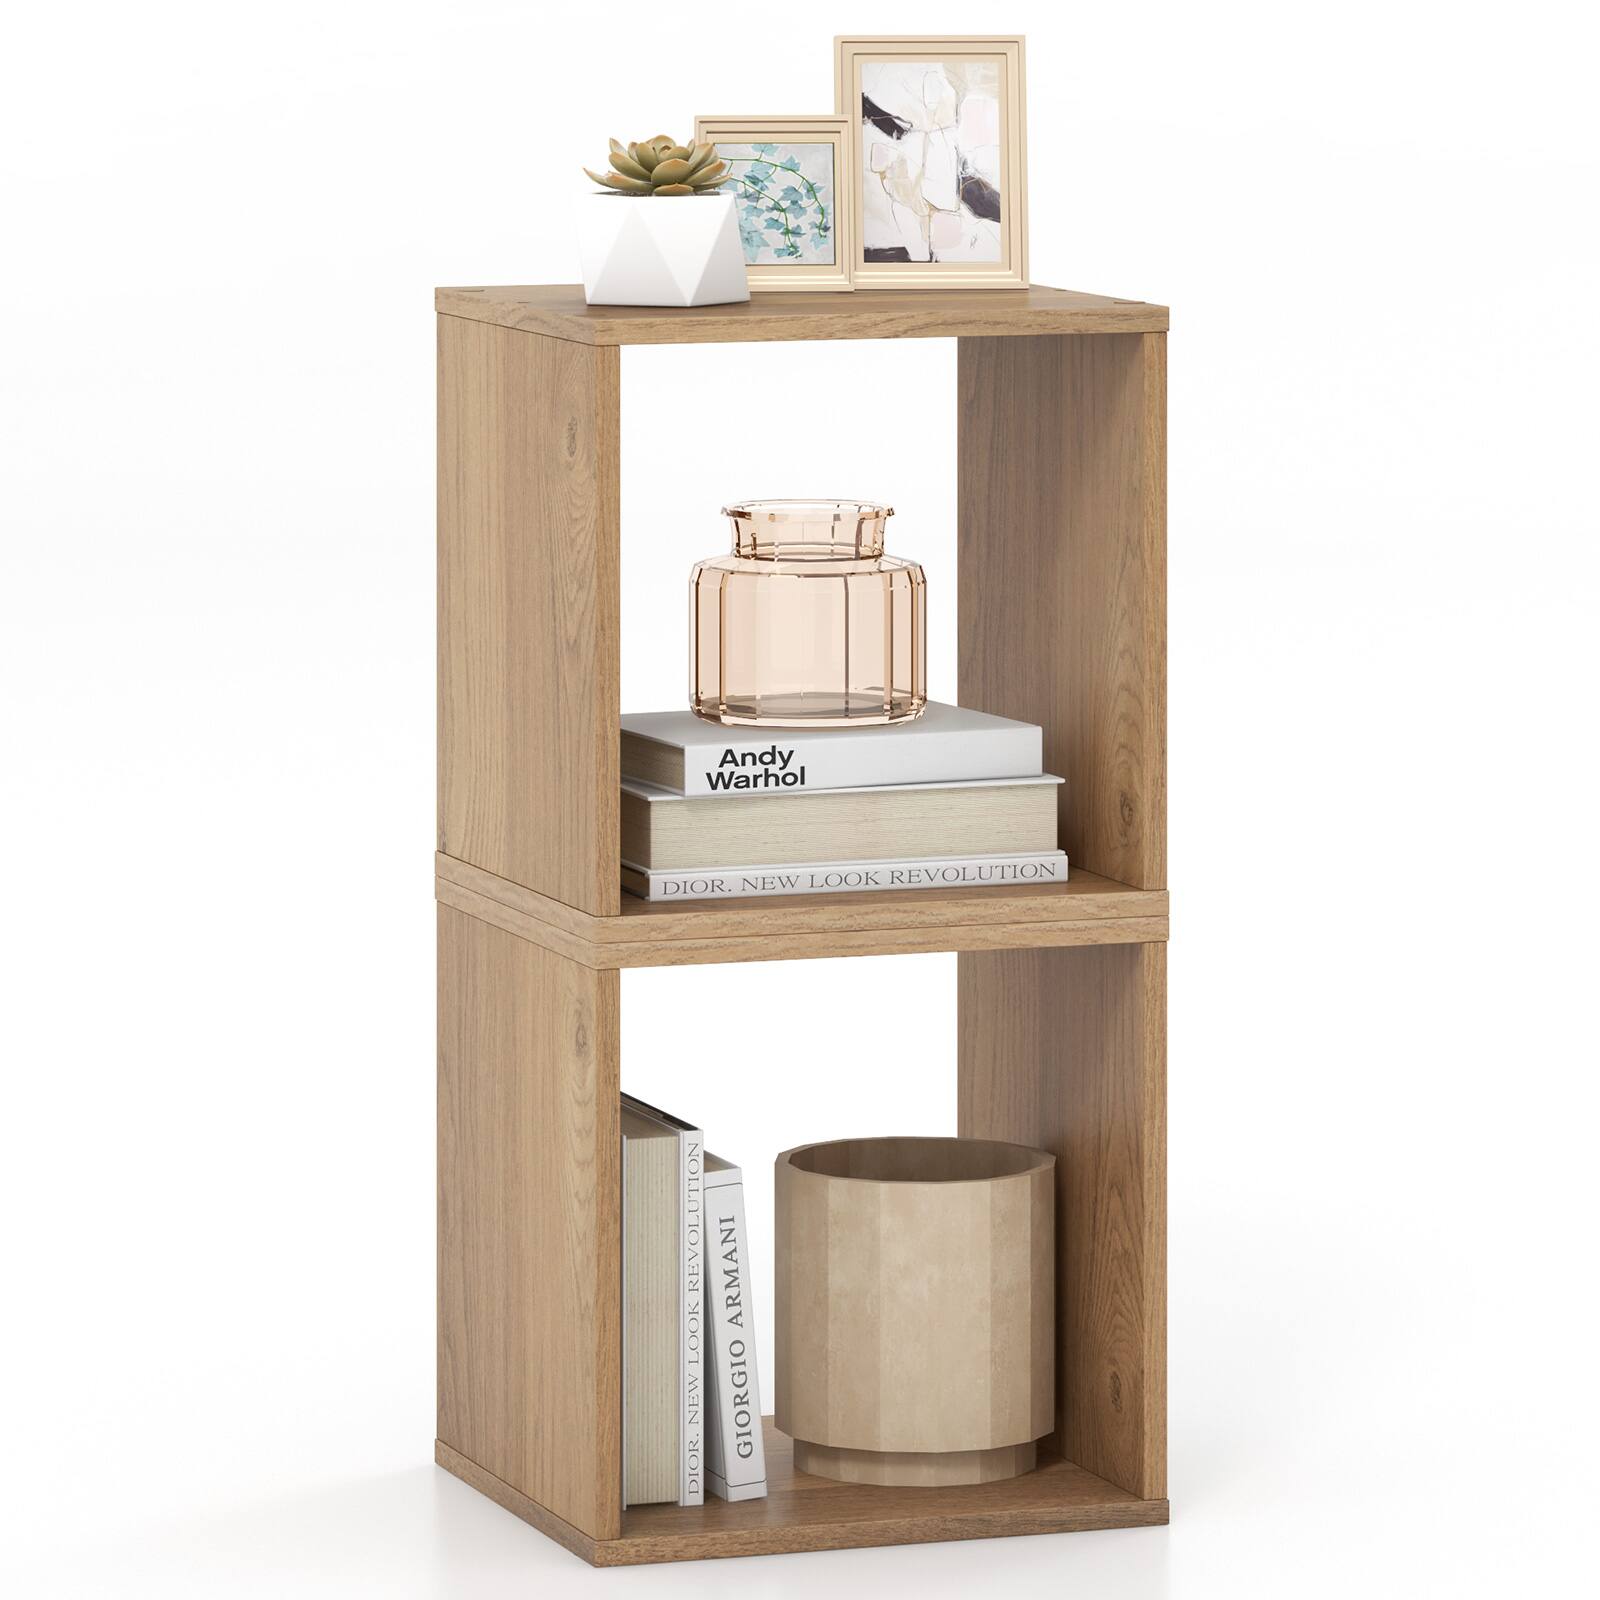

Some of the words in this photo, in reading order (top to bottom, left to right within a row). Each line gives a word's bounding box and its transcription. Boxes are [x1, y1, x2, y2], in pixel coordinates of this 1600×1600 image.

[706, 766, 806, 791] Warhol
[718, 745, 795, 770] Andy
[662, 877, 733, 896] DIOR.
[741, 873, 801, 892] NEW
[809, 870, 881, 889] LOOK
[889, 862, 1056, 884] REVOLUTION
[688, 1142, 700, 1292] REVOLUTION
[719, 1215, 744, 1328] ARMANI
[688, 1300, 700, 1365] LOOK
[688, 1373, 700, 1425] NEW
[728, 1340, 754, 1459] GIORGIO
[688, 1432, 700, 1495] DIOR.
